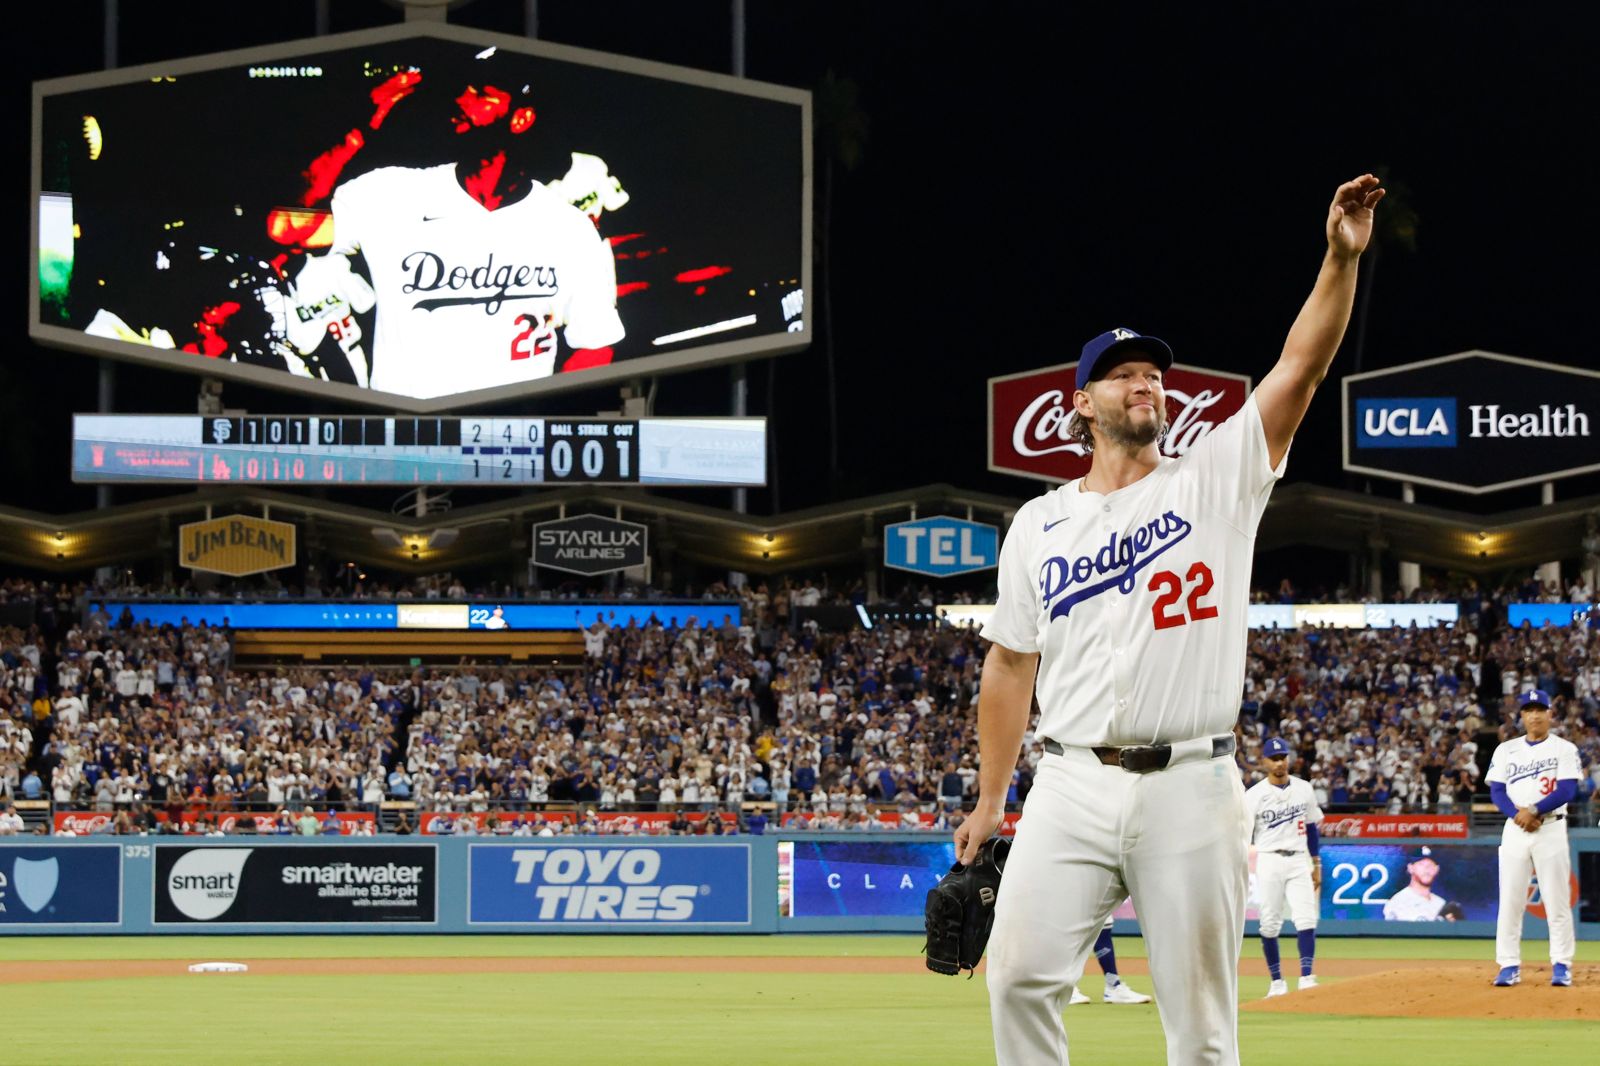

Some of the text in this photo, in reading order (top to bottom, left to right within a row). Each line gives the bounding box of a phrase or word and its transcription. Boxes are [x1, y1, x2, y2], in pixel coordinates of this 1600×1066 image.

[401, 251, 559, 316] Dodgers
[249, 421, 257, 442] 1
[270, 421, 281, 442] 0
[294, 421, 302, 442] 1
[324, 421, 335, 443] 0
[472, 424, 482, 443] 2
[503, 424, 512, 443] 4
[528, 424, 539, 443] 0
[551, 424, 634, 436] BALL STRIKE OUT
[1364, 404, 1590, 438] UCLA Health
[247, 458, 259, 479] 0
[293, 458, 304, 480] 0
[323, 460, 334, 480] 0
[473, 459, 480, 478] 1
[503, 459, 512, 478] 2
[530, 459, 536, 478] 1
[551, 440, 630, 477] 0 0 1
[188, 521, 285, 562] JIM BEAM
[539, 530, 640, 546] STARLUX
[897, 527, 985, 565] TEL
[555, 548, 625, 559] AIRLINES
[1039, 510, 1192, 624] Dodgers
[1147, 561, 1219, 631] 22
[470, 609, 489, 624] 22
[1506, 757, 1559, 785] Dodgers
[1366, 822, 1377, 833] A
[1377, 822, 1397, 833] HIT
[1437, 822, 1464, 833] TIME
[125, 845, 150, 858] 375
[281, 862, 422, 884] smartwater
[511, 849, 661, 884] TOYO
[172, 872, 235, 890] smart
[318, 884, 418, 898] alkaline 9.5+pH
[1332, 863, 1390, 905] 22
[207, 890, 235, 899] water
[352, 898, 371, 907] with
[535, 884, 698, 920] TIRES
